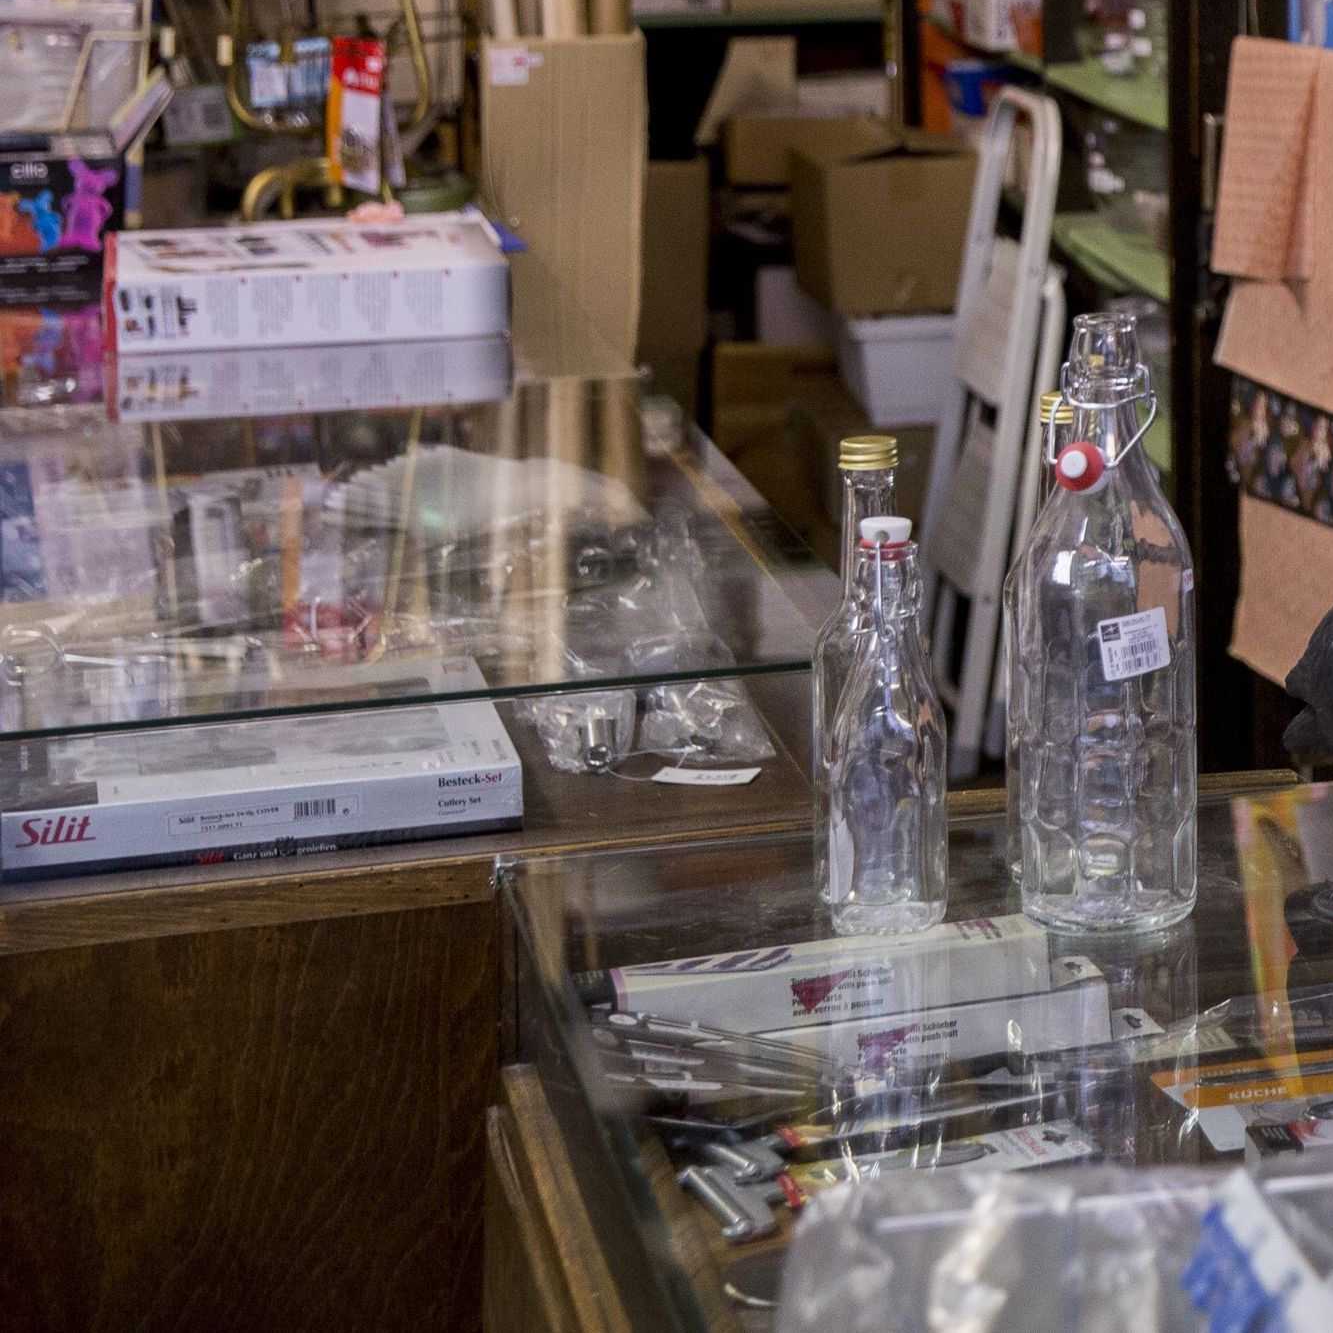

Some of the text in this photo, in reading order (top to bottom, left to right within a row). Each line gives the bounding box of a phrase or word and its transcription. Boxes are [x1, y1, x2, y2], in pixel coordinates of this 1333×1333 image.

[438, 772, 503, 789] Besteck-Set
[14, 815, 97, 849] Silit
[922, 1020, 958, 1032] Schieber
[921, 1032, 941, 1043] push
